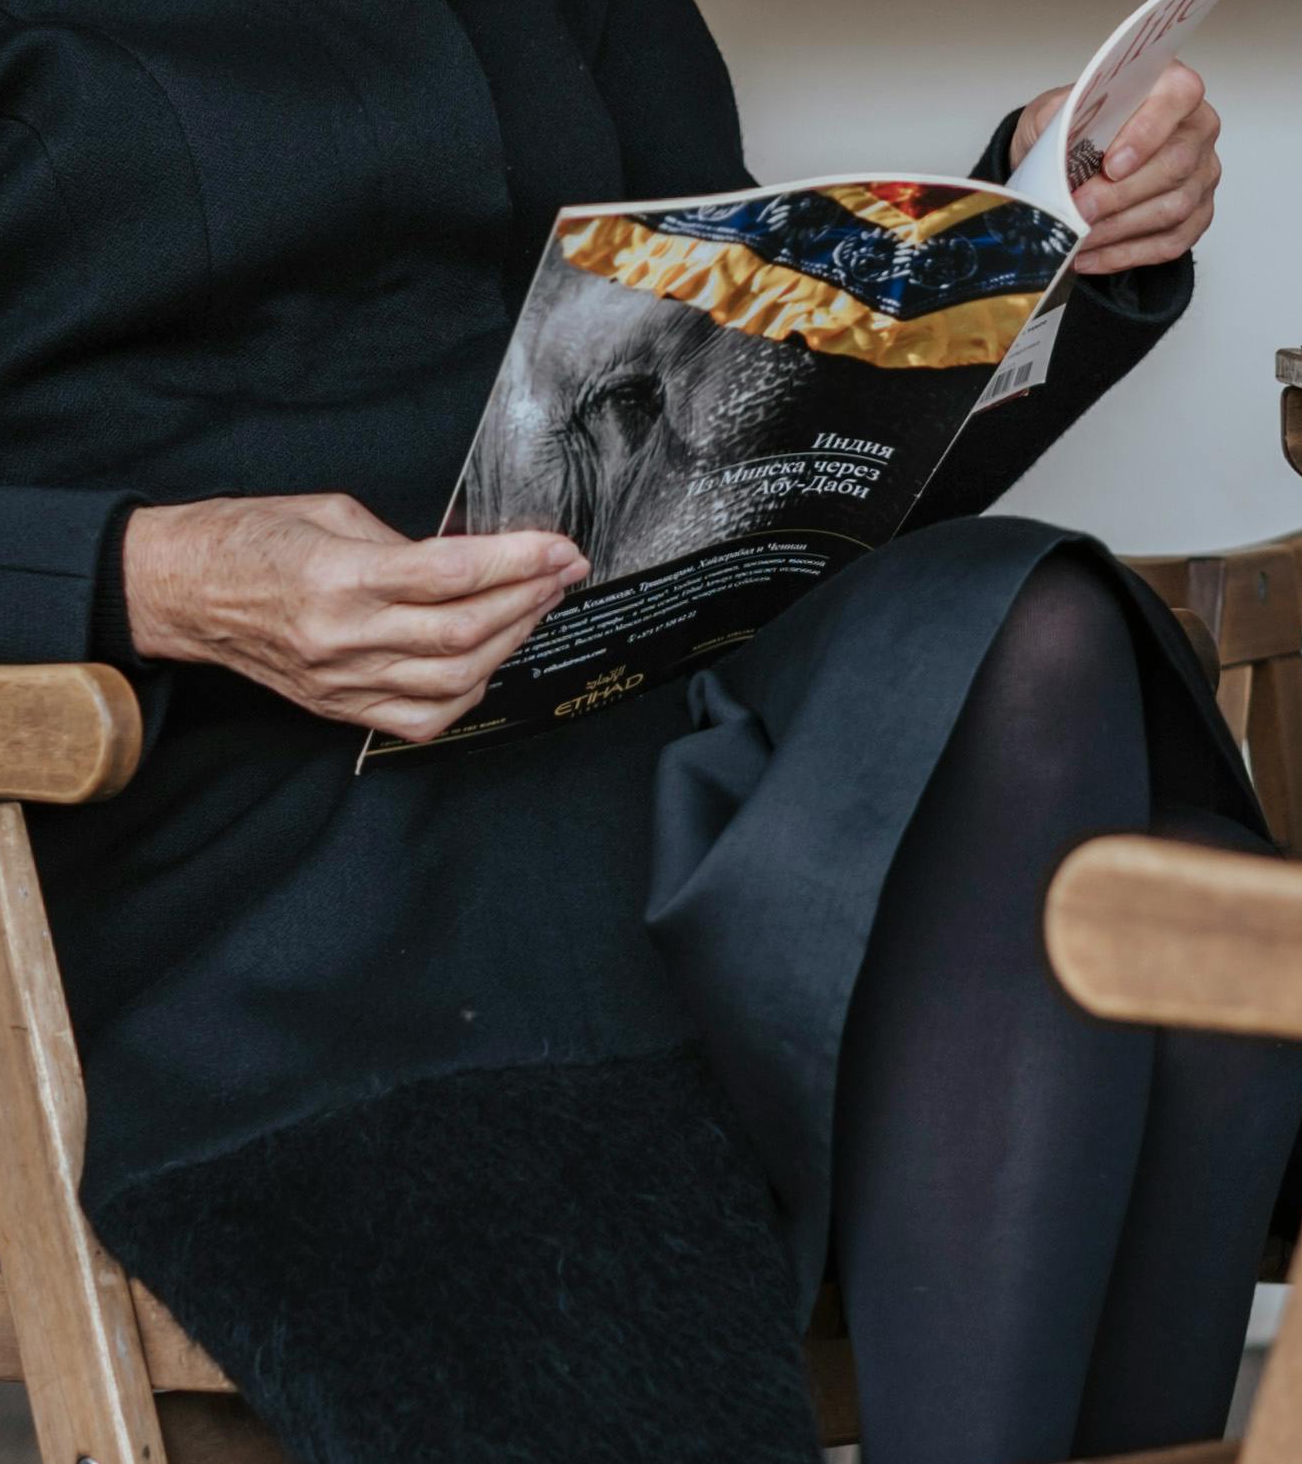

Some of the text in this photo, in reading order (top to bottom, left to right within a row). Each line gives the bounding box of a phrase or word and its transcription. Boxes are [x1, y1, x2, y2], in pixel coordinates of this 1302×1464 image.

[810, 432, 896, 460] Индия
[687, 458, 882, 498] Из Минска через
[751, 474, 872, 500] Абу-Даби
[554, 672, 646, 717] ETIHAD
